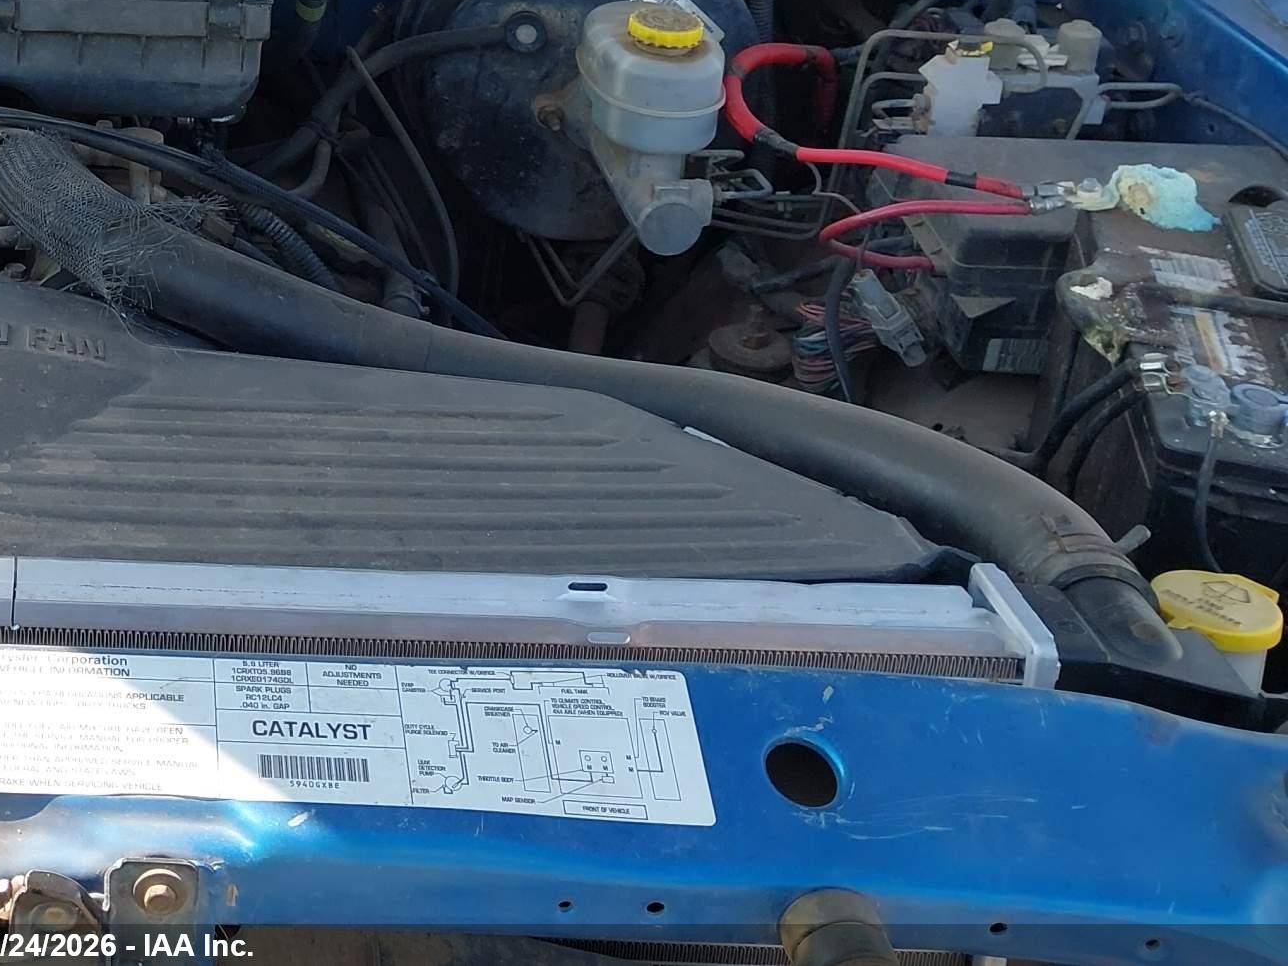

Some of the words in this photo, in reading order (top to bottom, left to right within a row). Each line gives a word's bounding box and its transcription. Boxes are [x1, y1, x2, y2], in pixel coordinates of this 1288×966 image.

[26, 326, 106, 361] FAN
[48, 653, 128, 667] Corporation
[322, 671, 382, 679] ADJUSTMENTS
[336, 679, 369, 687] NEEDED
[235, 685, 263, 693] SPARK
[265, 686, 291, 694] PLUGS
[126, 691, 185, 702] APPLICABLE
[240, 701, 259, 709] .040
[252, 719, 372, 741] CATALYST
